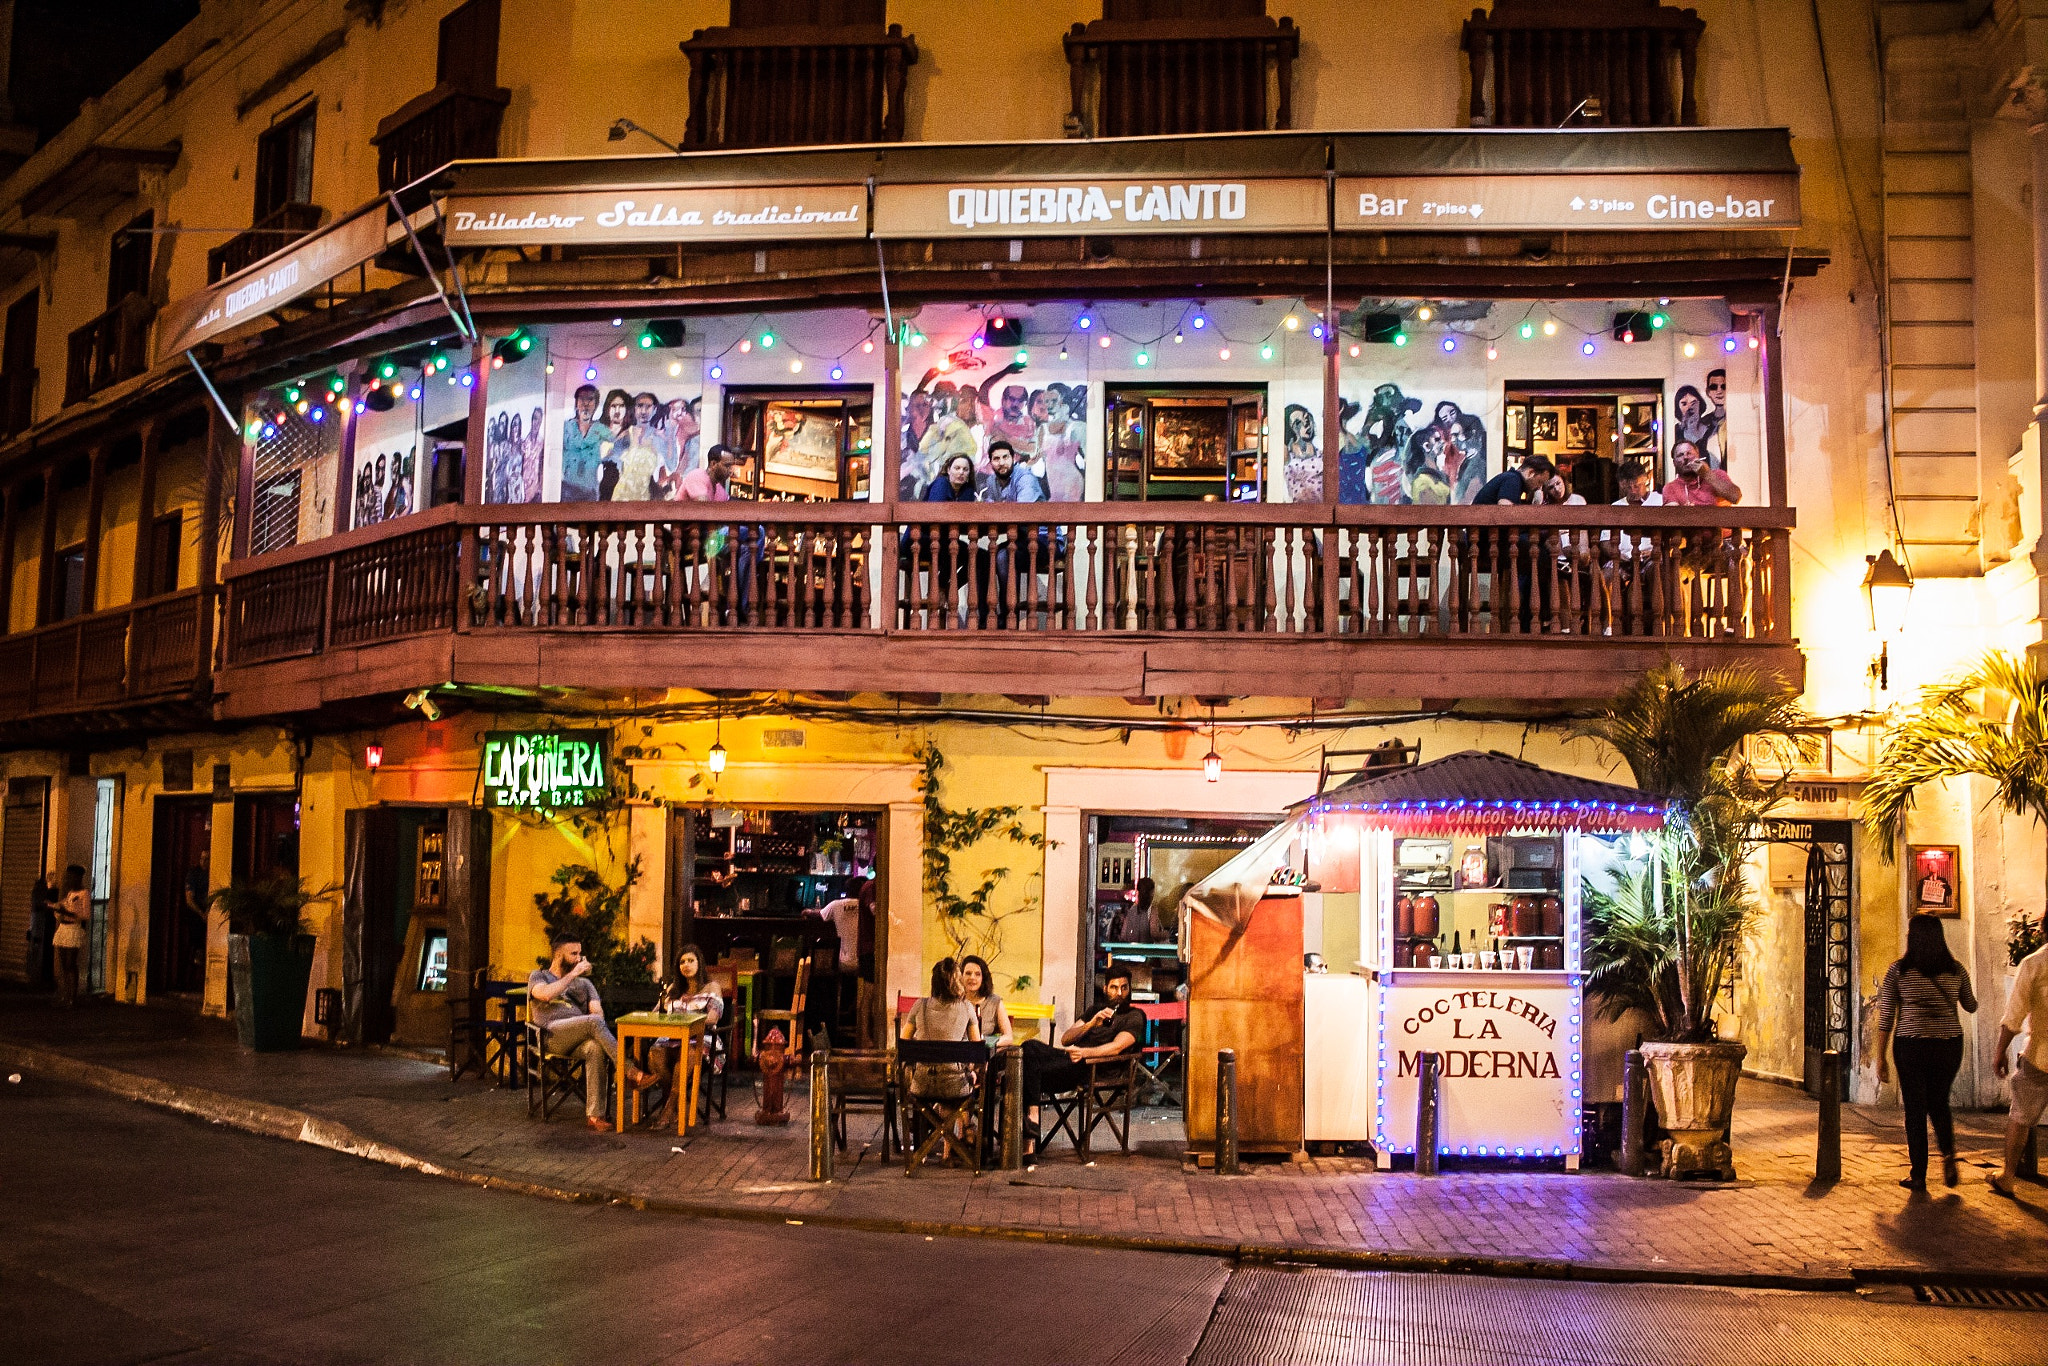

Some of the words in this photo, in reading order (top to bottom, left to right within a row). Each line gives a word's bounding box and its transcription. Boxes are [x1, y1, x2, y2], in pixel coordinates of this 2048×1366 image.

[454, 211, 584, 231] Bailadero
[596, 201, 704, 227] Salsa
[711, 204, 859, 226] tradicional
[948, 184, 1246, 228] QUIEBRA-CANTO
[1359, 193, 1408, 217] Bar
[1646, 194, 1775, 219] Cine-bar
[225, 260, 299, 319] QUIEBRA-CANTO
[551, 789, 584, 806] BAR
[1445, 804, 1506, 825] CARACOL
[1514, 806, 1568, 826] OSTRAS
[1575, 804, 1628, 827] PULPO
[1403, 991, 1558, 1040] COCTELERIA
[1453, 1018, 1502, 1040] LA
